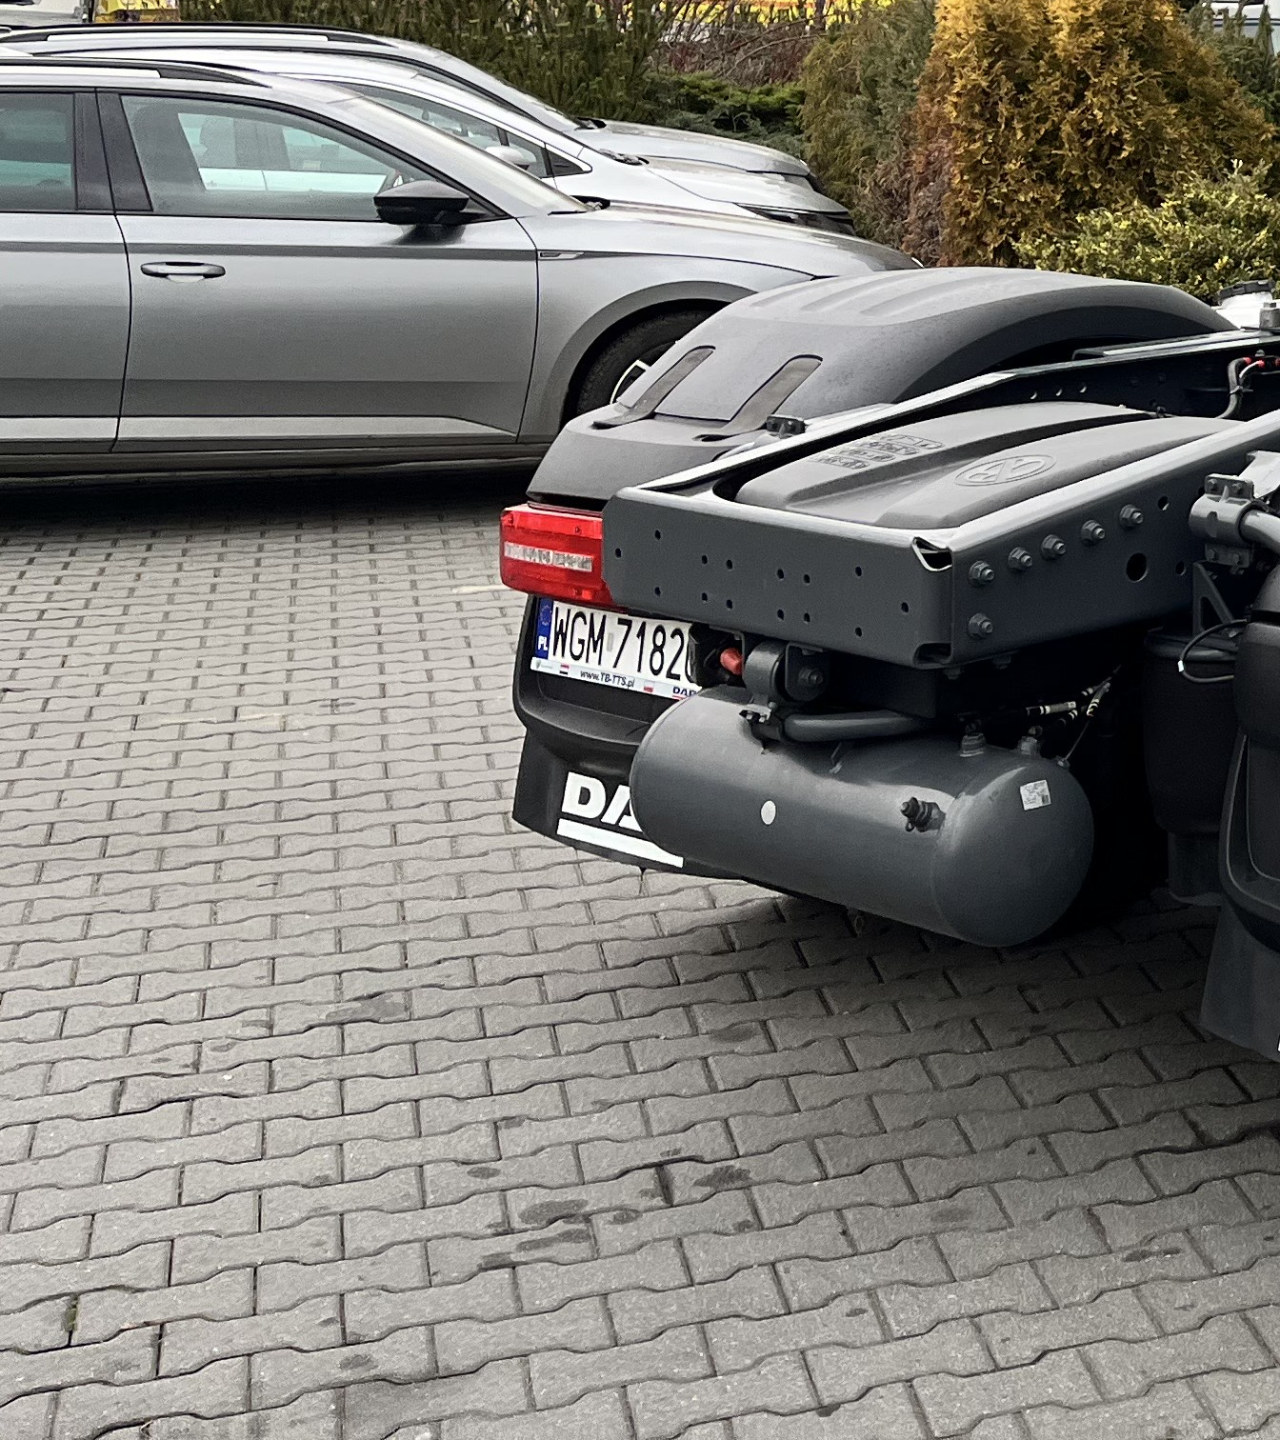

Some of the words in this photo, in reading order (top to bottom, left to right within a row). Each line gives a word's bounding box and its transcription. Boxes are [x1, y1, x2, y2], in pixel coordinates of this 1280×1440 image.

[538, 635, 549, 651] PL
[553, 607, 606, 666] WGM
[613, 618, 695, 683] 7182
[561, 771, 643, 832] DA
